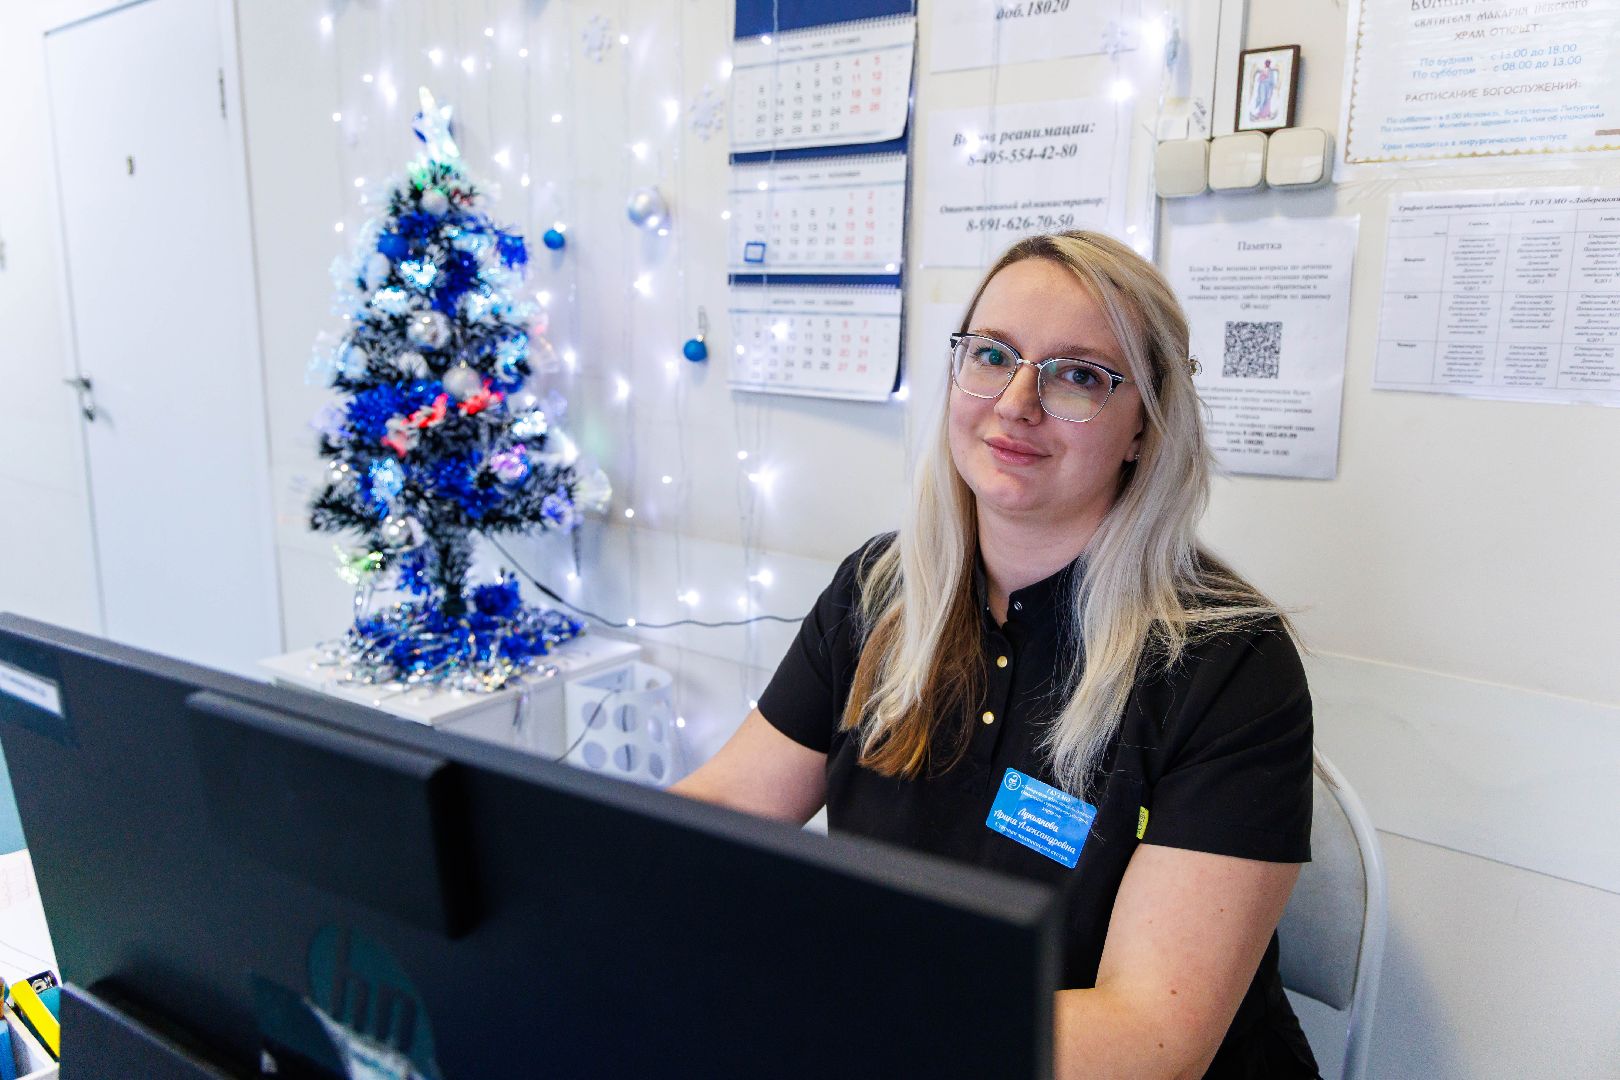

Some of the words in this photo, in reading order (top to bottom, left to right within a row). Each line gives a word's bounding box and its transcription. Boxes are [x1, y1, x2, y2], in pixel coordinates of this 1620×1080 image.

[1455, 30, 1486, 40] ХРАМ
[1420, 58, 1435, 67] По
[1530, 49, 1544, 57] до
[1412, 69, 1428, 79] По
[1430, 67, 1476, 79] субботам
[1535, 60, 1549, 70] до
[1404, 87, 1479, 103] РАСПИСАНИЕ
[1482, 80, 1583, 98] БОГОСЛУЖЕНИЙ:
[1000, 122, 1097, 145] реанимации:
[967, 144, 1078, 166] 8-495-554-42-80
[966, 213, 1075, 232] 8-991-626-70-50
[1237, 241, 1282, 251] Памятка
[1018, 807, 1059, 833] Лукьянова
[994, 809, 1018, 826] Арина
[1018, 821, 1077, 855] Александровна
